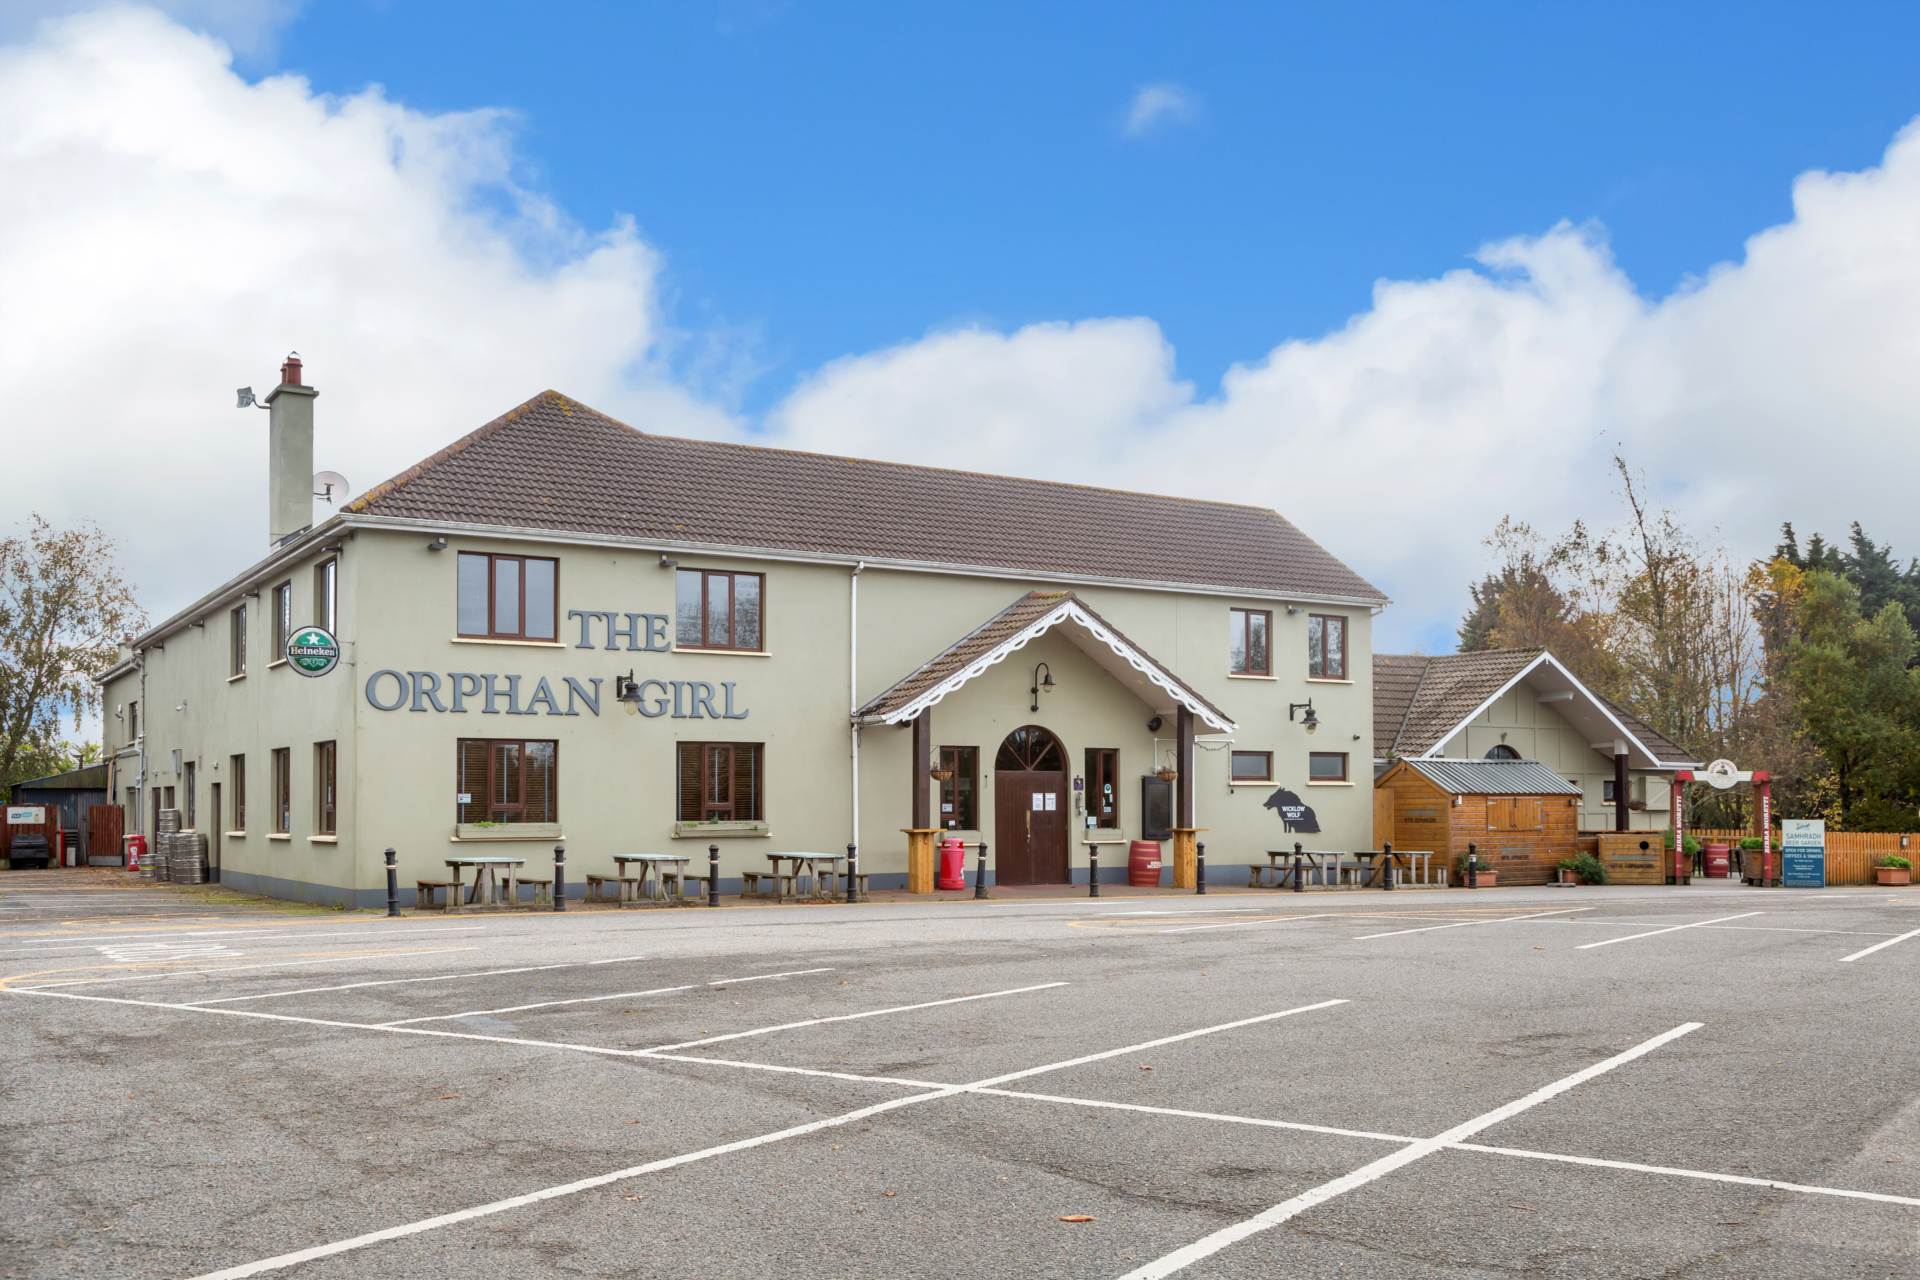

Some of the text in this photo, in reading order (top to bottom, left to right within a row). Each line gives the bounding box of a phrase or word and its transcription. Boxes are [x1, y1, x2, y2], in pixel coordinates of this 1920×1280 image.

[290, 646, 335, 656] Heineken
[568, 609, 672, 652] THE
[365, 669, 749, 720] ORPHAN GIRL
